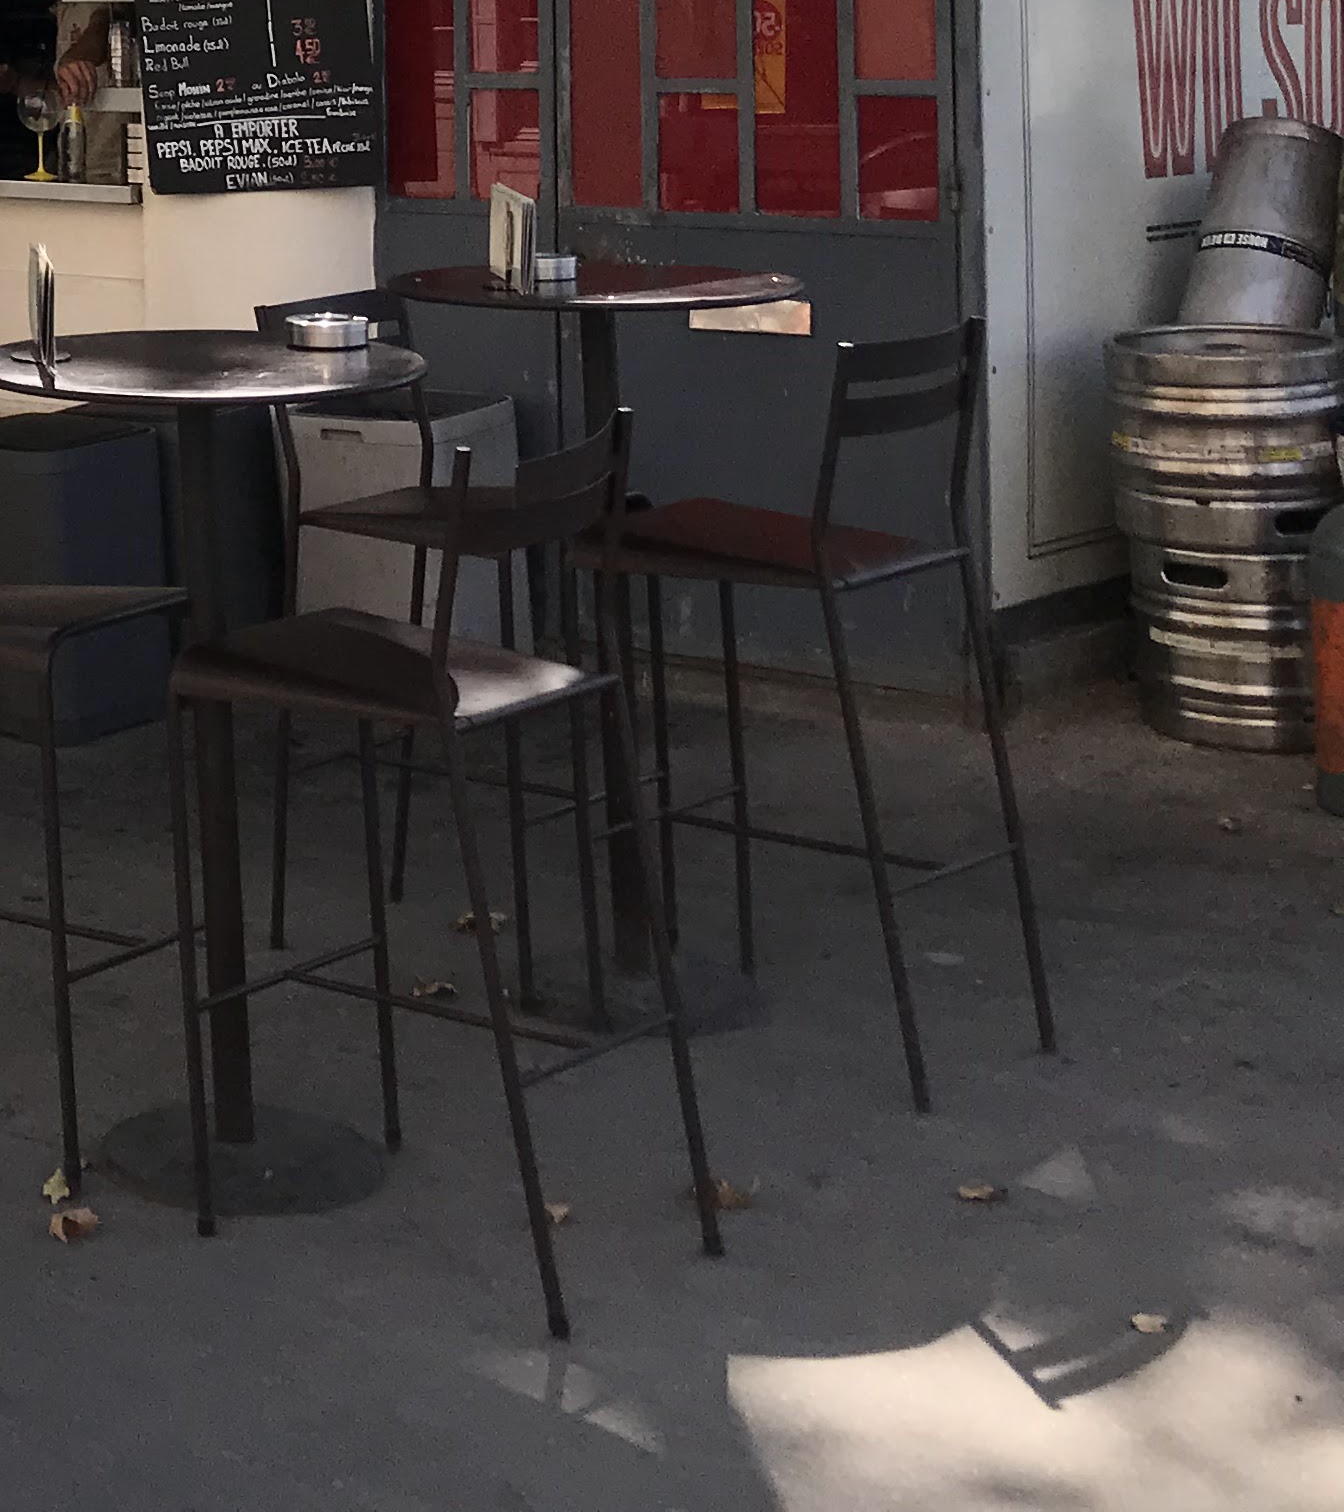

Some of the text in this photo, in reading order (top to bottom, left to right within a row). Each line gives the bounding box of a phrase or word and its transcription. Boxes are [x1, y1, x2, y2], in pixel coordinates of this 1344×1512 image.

[145, 56, 189, 71] Red Bull
[266, 72, 305, 88] Diabolo
[214, 124, 224, 138] A
[231, 119, 299, 138] EMPORTER
[200, 138, 239, 156] PEPSI
[282, 139, 303, 153] ICE
[304, 138, 332, 154] TEA
[180, 156, 223, 172] BADOIT
[226, 171, 268, 189] EVIAN
